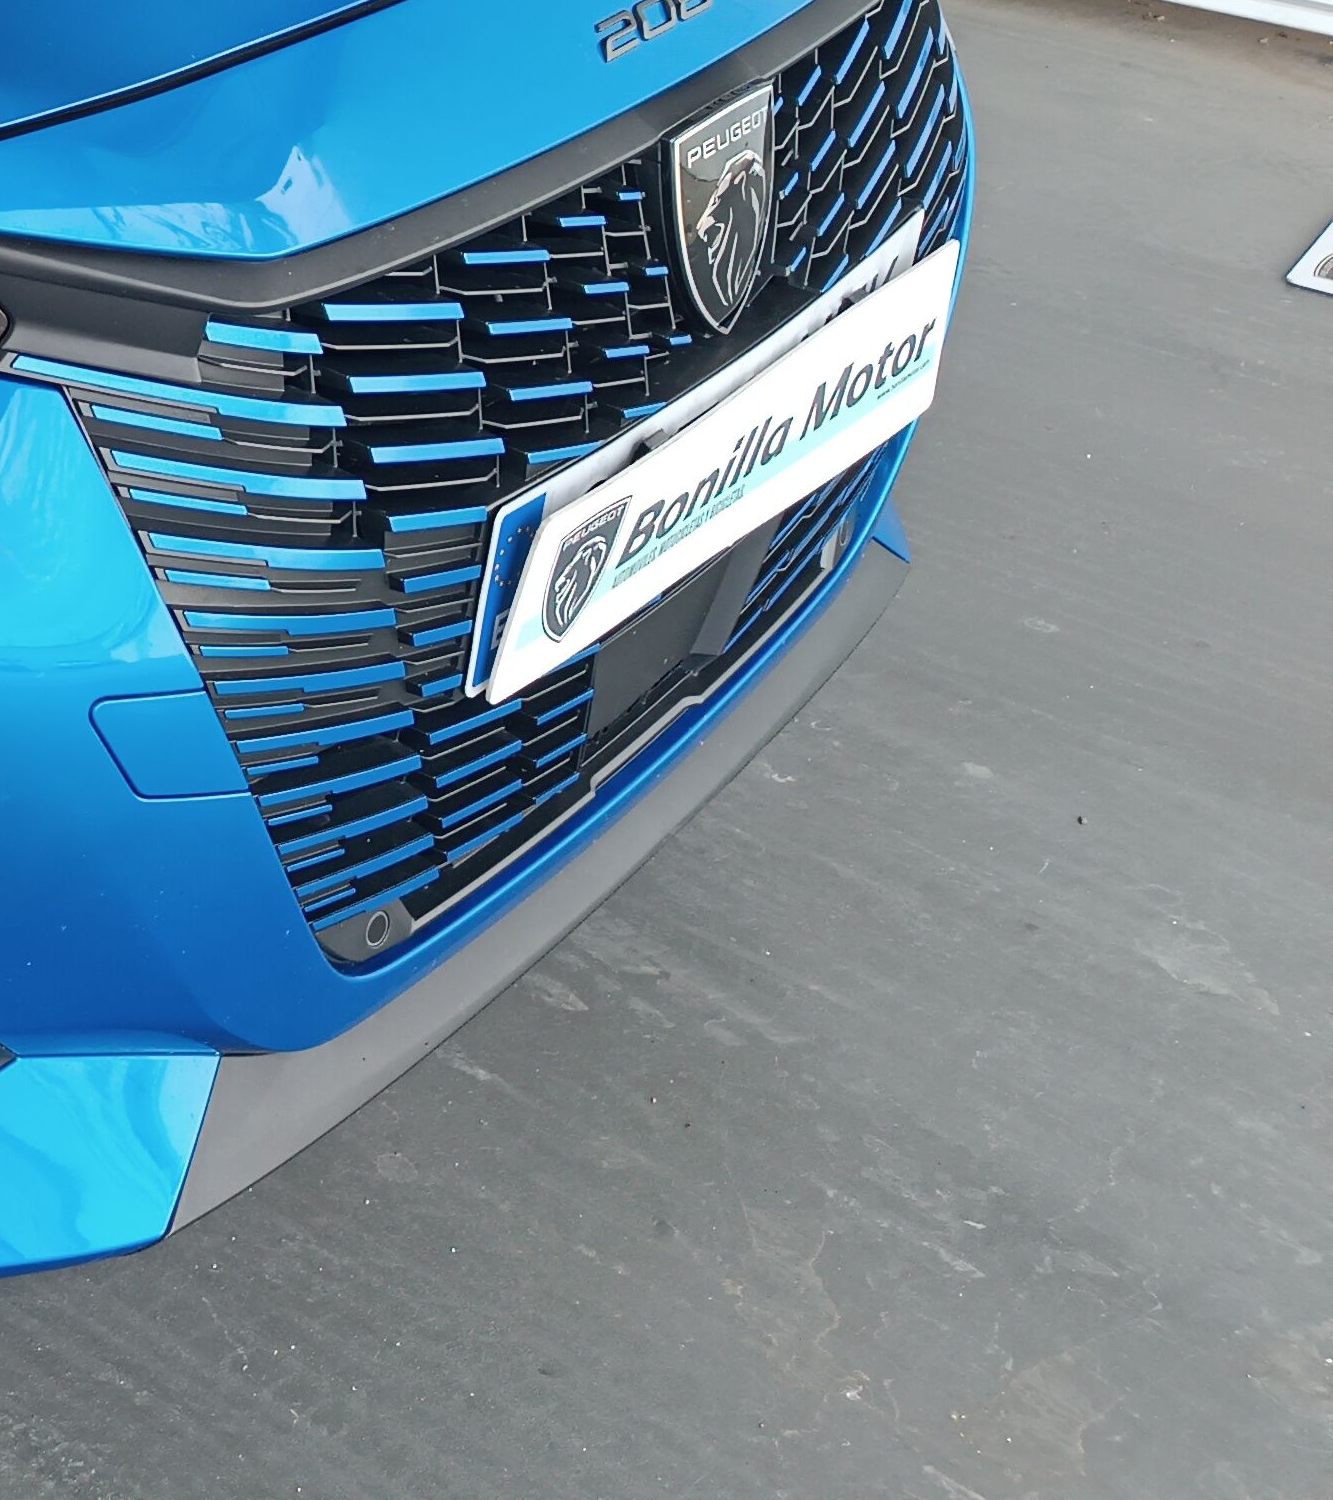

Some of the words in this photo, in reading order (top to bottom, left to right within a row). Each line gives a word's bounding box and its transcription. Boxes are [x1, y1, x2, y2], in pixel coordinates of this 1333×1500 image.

[687, 105, 769, 169] PEUGEOT
[615, 411, 794, 569] Bonilla
[800, 317, 937, 442] Motor
